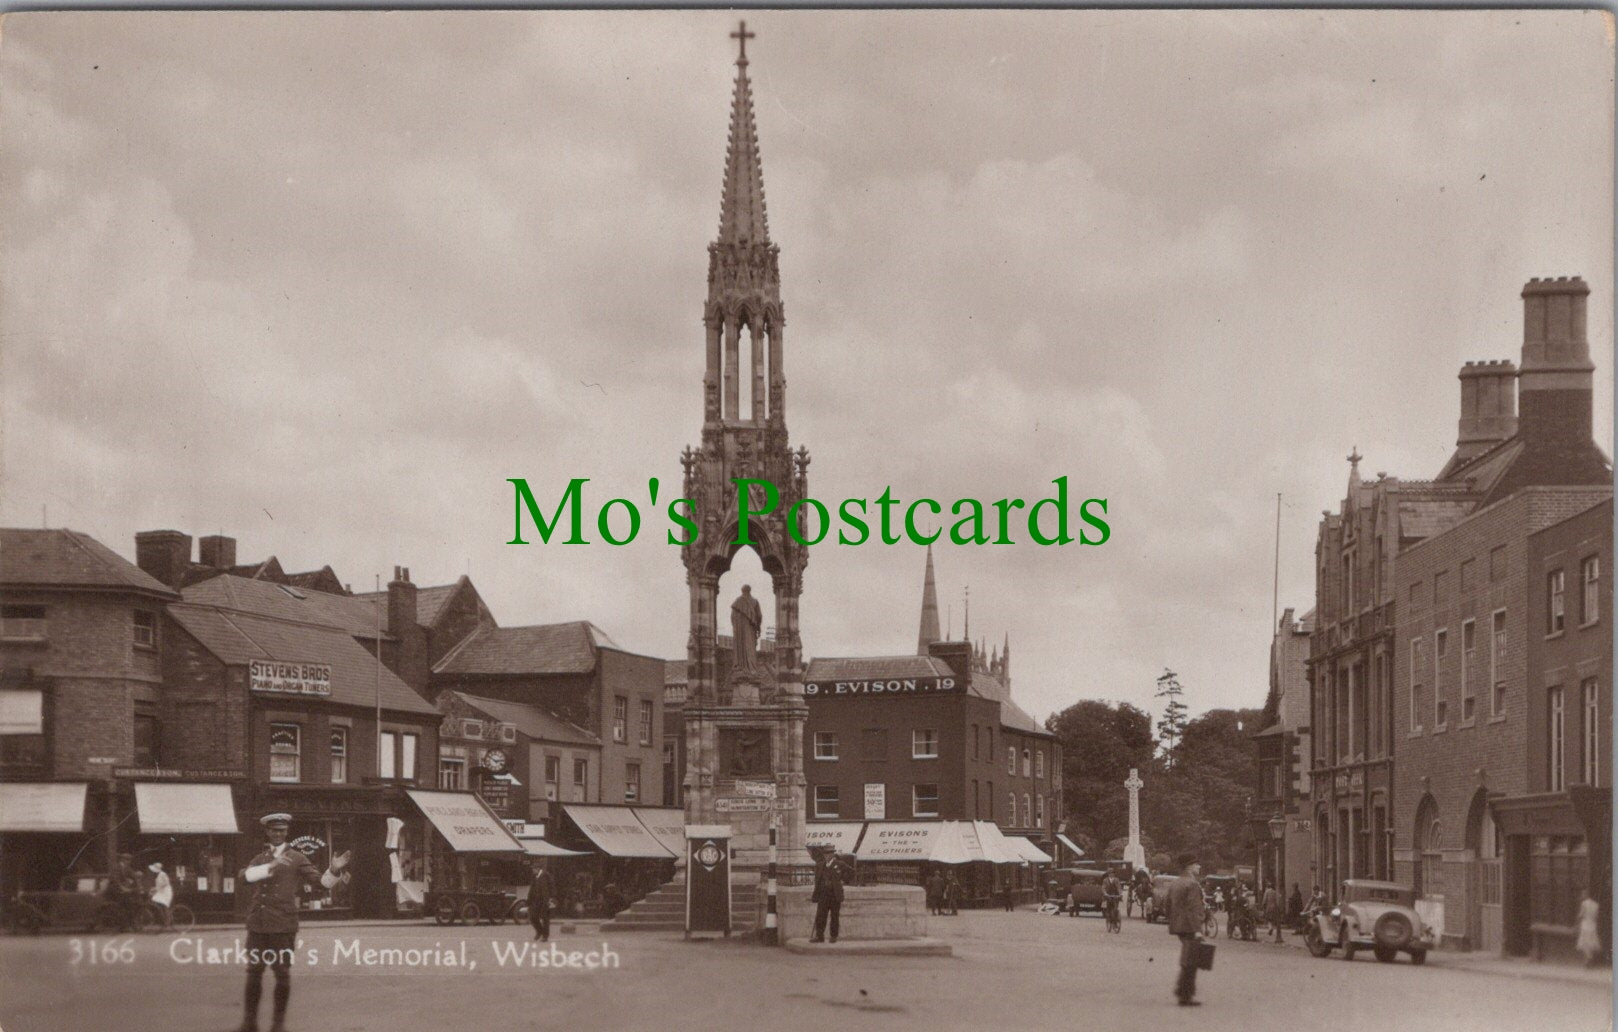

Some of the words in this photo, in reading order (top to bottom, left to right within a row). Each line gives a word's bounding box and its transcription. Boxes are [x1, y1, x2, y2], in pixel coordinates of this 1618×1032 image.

[251, 661, 299, 679] STEVENS
[301, 665, 330, 681] BROS
[252, 678, 273, 689] PIANO
[283, 681, 303, 691] ORGAN
[304, 682, 330, 692] TUNERS
[835, 679, 916, 694] EVISON
[936, 678, 956, 690] 19
